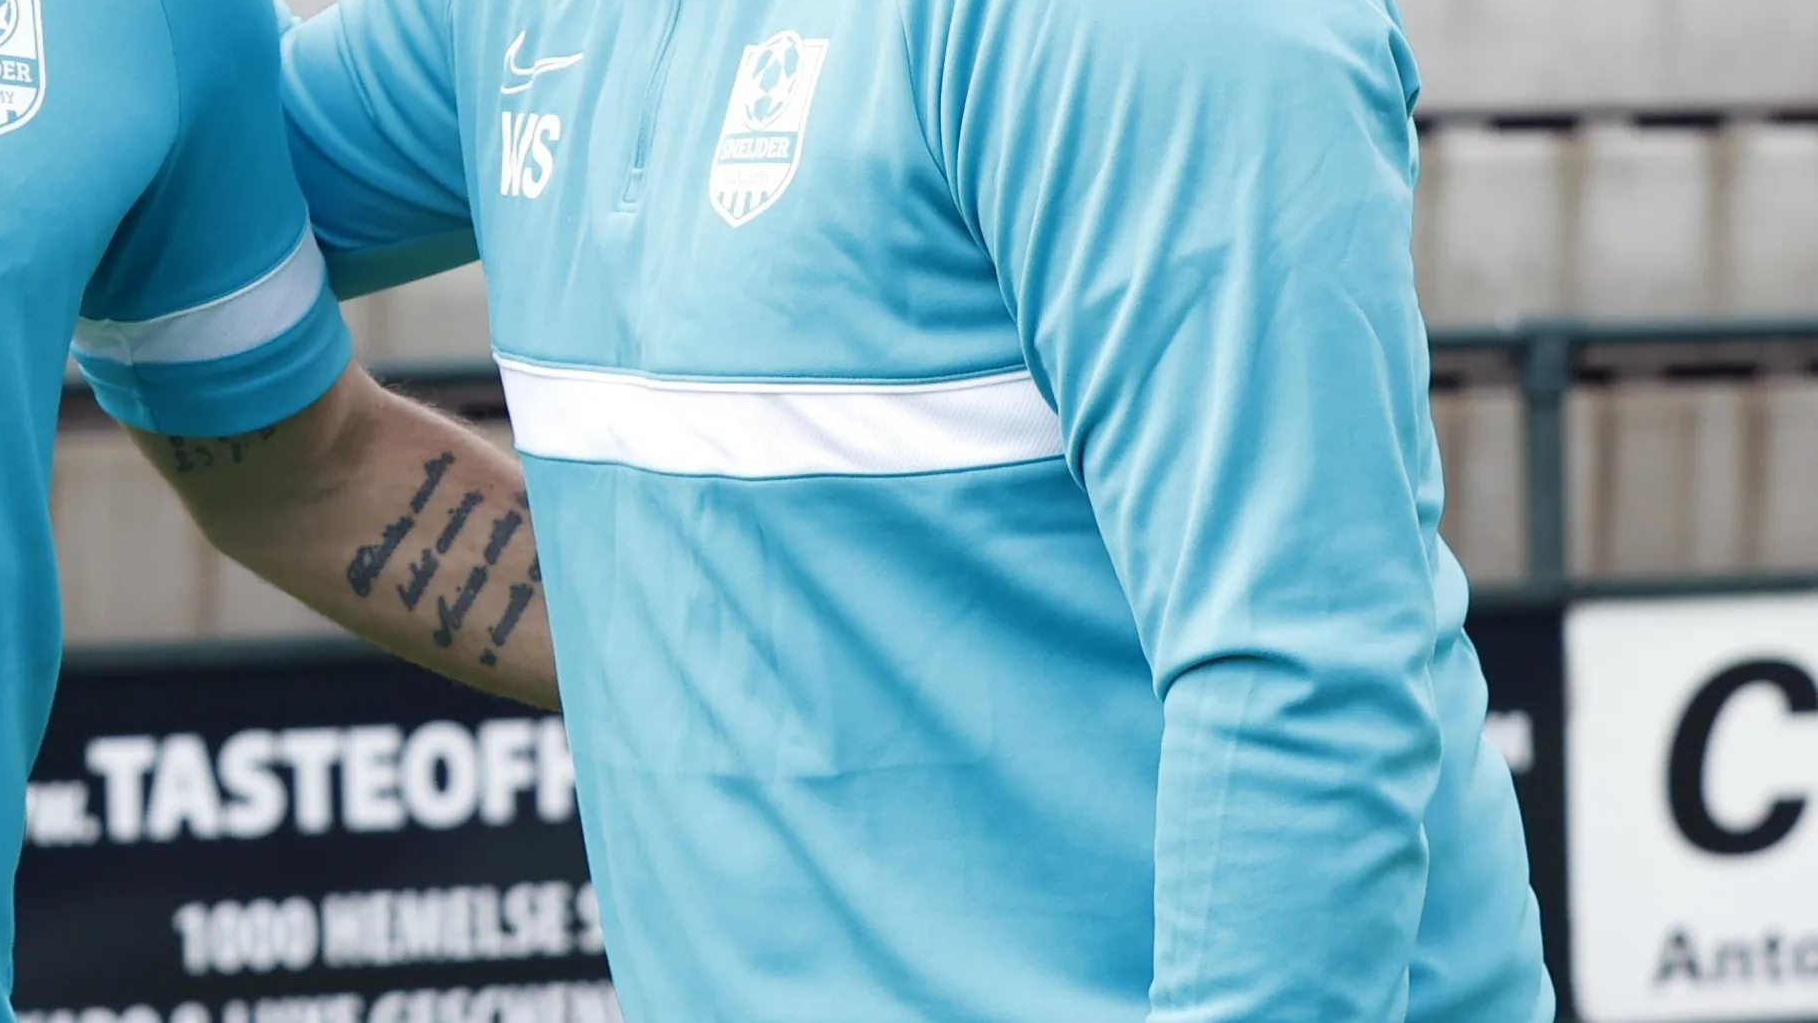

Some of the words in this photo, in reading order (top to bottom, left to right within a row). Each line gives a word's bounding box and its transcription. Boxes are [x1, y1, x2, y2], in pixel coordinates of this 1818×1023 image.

[500, 111, 561, 198] WS
[172, 894, 318, 975] 1000
[321, 880, 575, 968] HEMELSE
